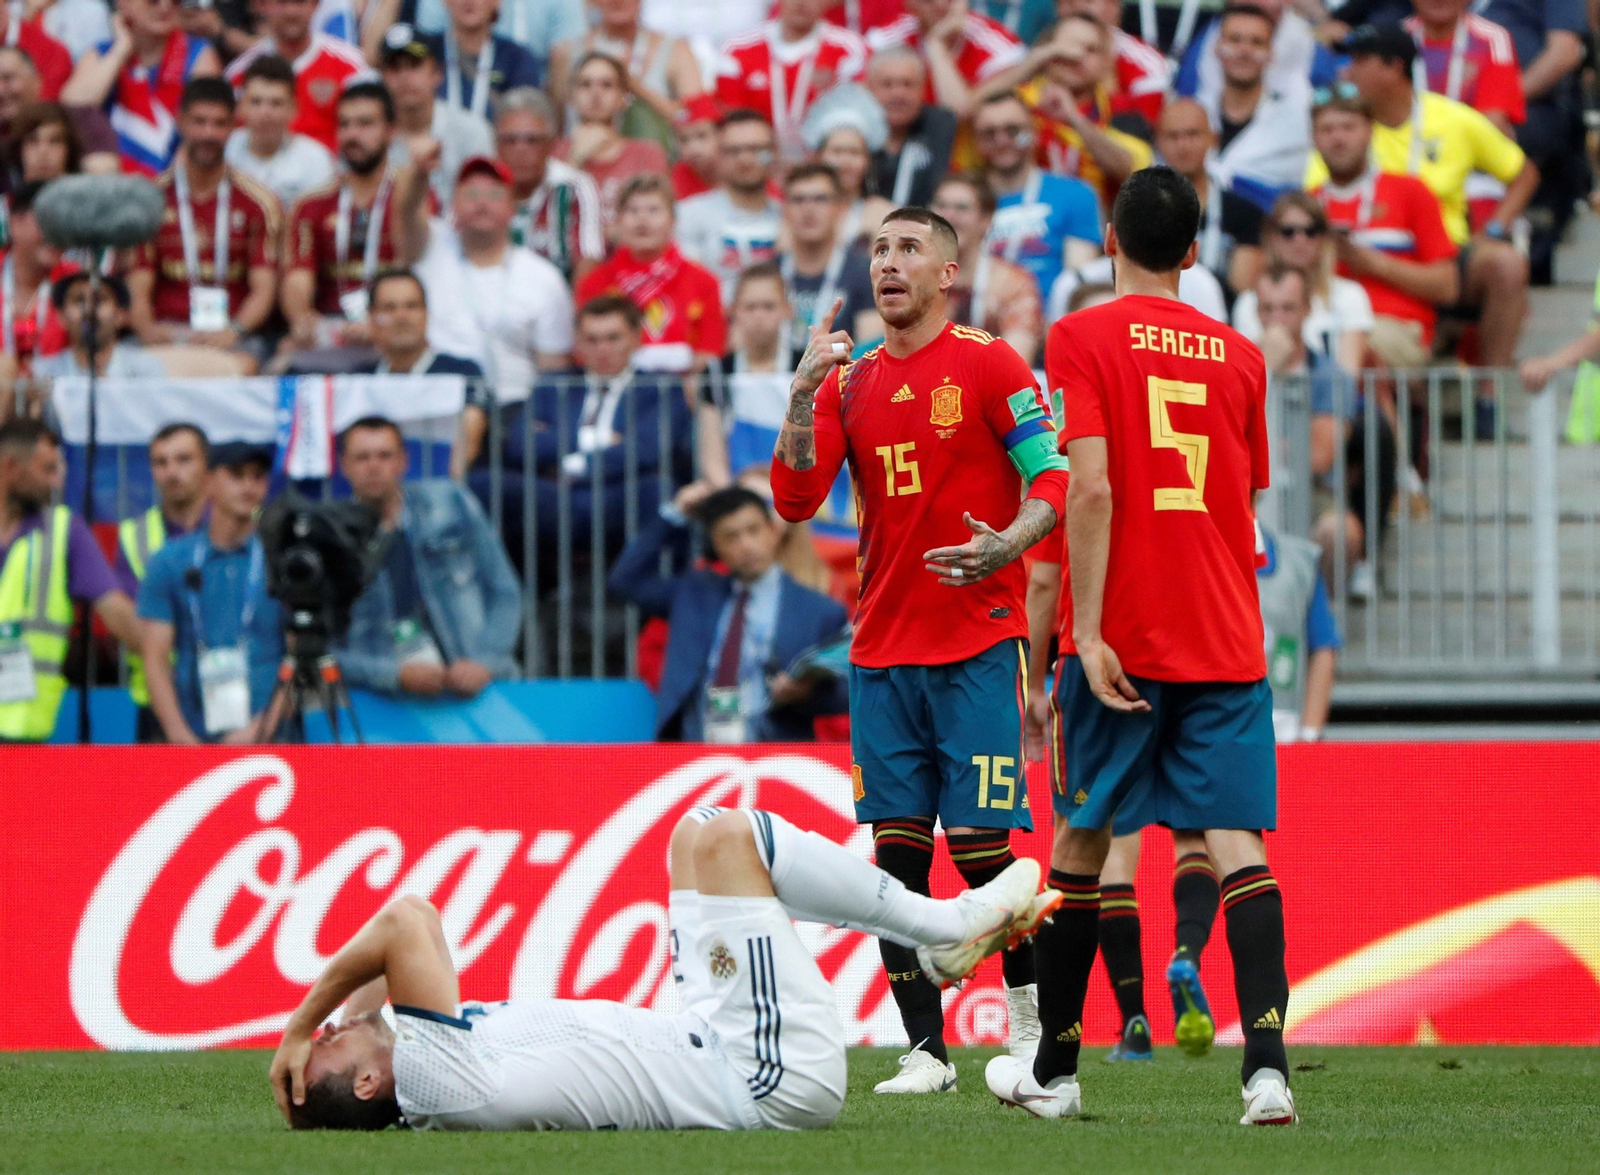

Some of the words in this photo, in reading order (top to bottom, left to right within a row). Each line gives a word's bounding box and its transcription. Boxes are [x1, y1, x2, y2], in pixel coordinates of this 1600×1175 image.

[1129, 323, 1225, 363] SERGIO
[875, 441, 922, 497] 15
[1147, 375, 1209, 513] 5
[971, 755, 1015, 810] 15
[1253, 1021, 1282, 1030] adidas
